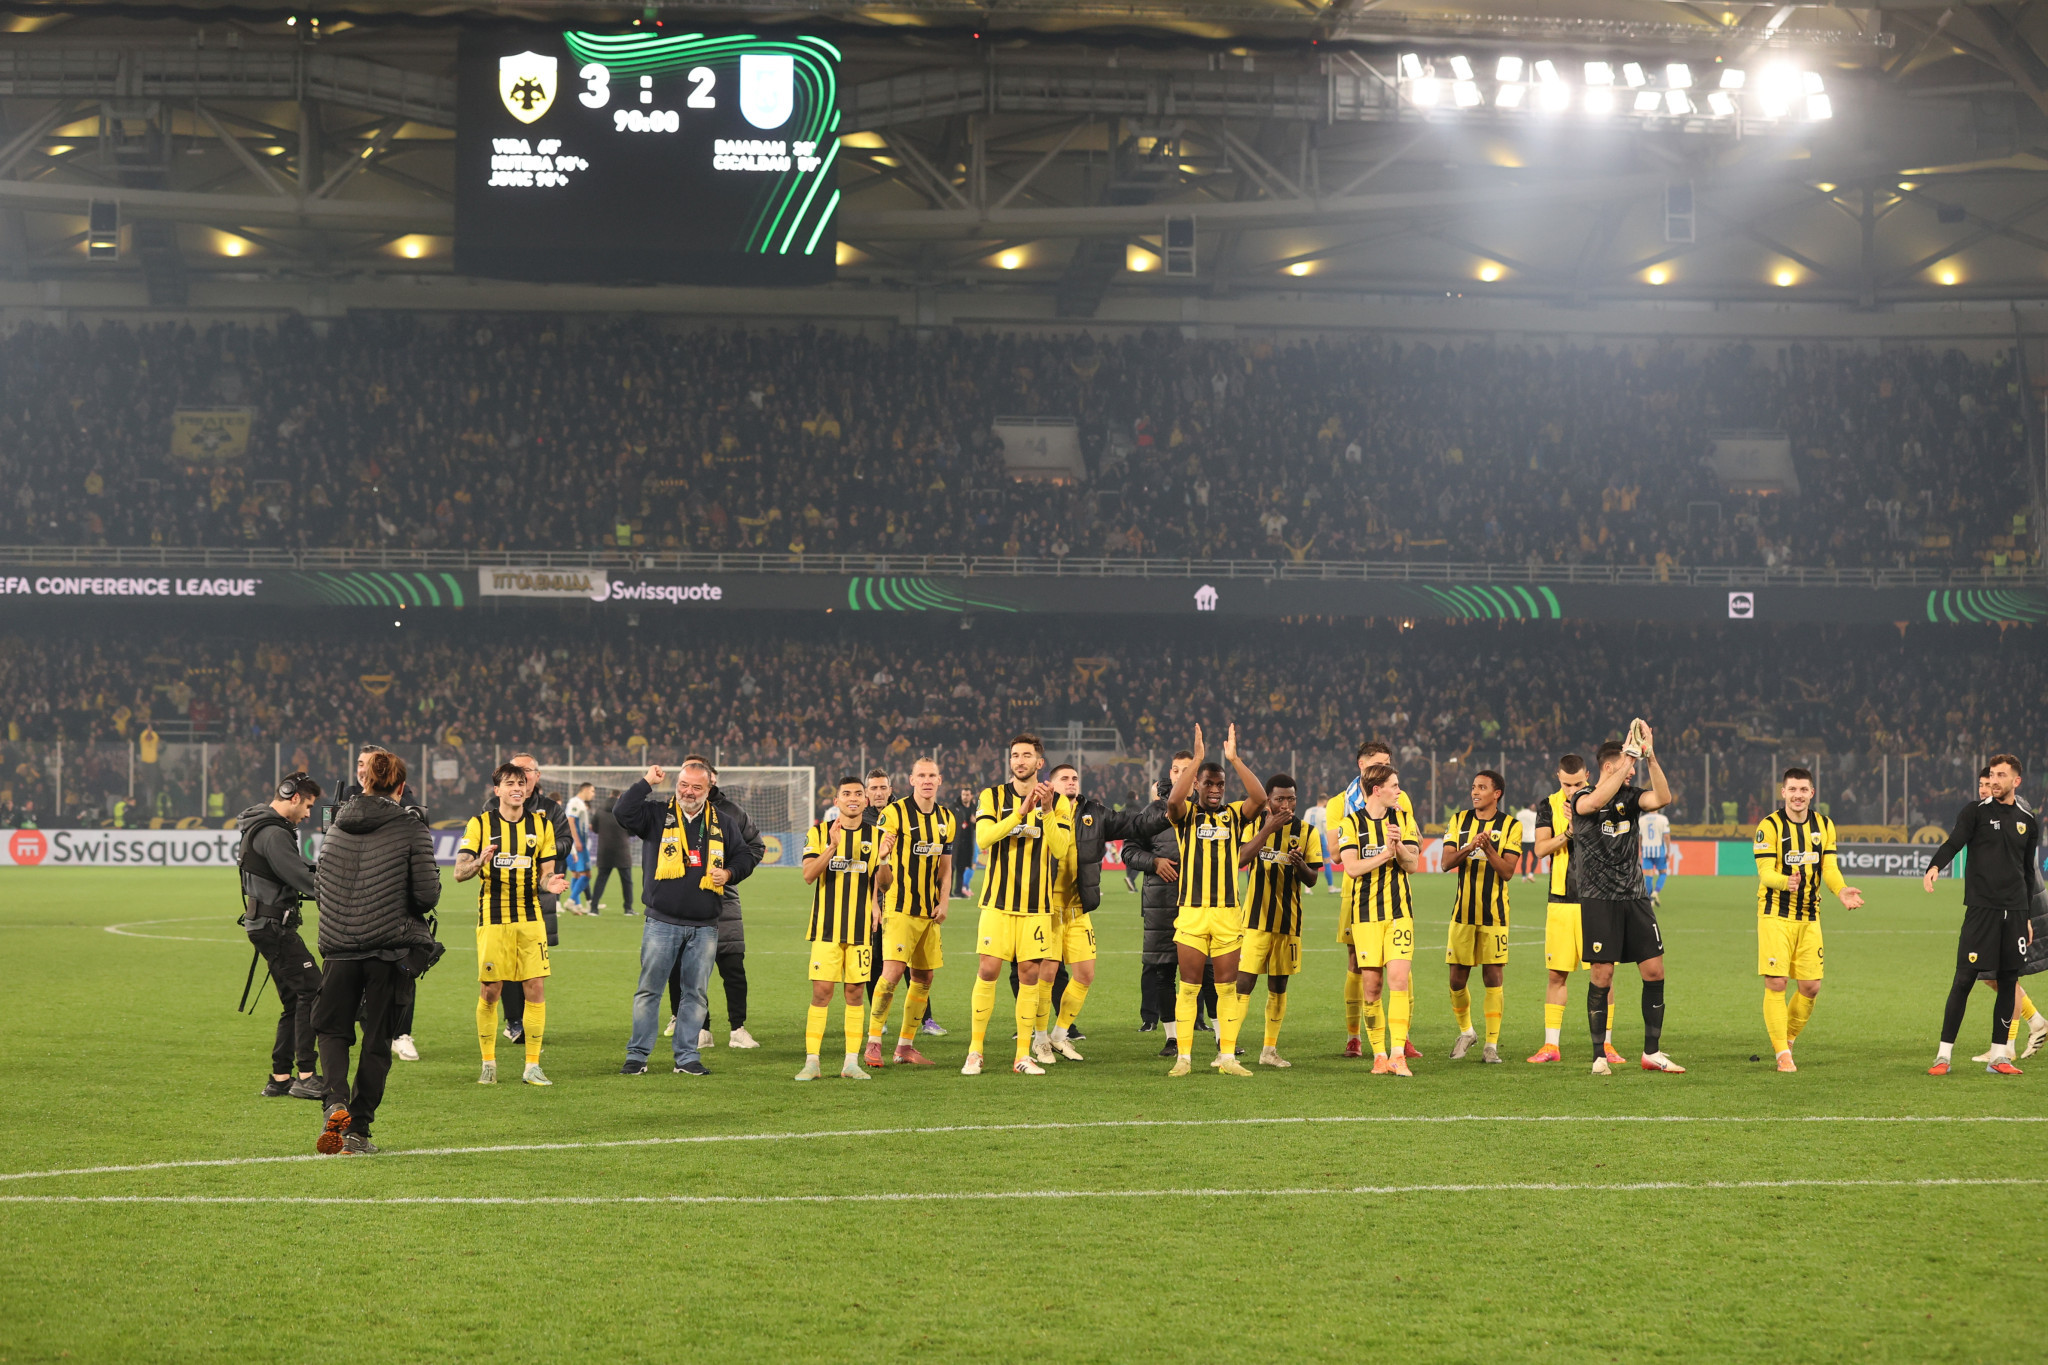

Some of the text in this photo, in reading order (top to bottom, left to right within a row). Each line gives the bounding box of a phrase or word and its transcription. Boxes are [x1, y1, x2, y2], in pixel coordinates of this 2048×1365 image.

[578, 63, 611, 108] 3
[687, 66, 716, 108] 2
[613, 109, 680, 133] 90:00
[35, 577, 170, 596] CONFERENCE
[175, 578, 255, 597] LEAGUE
[611, 580, 723, 605] Swissquote
[1648, 823, 1655, 841] 6
[1837, 851, 1949, 873] nterpris
[1034, 925, 1044, 943] 4
[1393, 929, 1412, 946] 29
[1653, 923, 1660, 942] 1
[1289, 943, 1298, 961] 11
[1495, 934, 1508, 952] 19
[857, 949, 871, 968] 13
